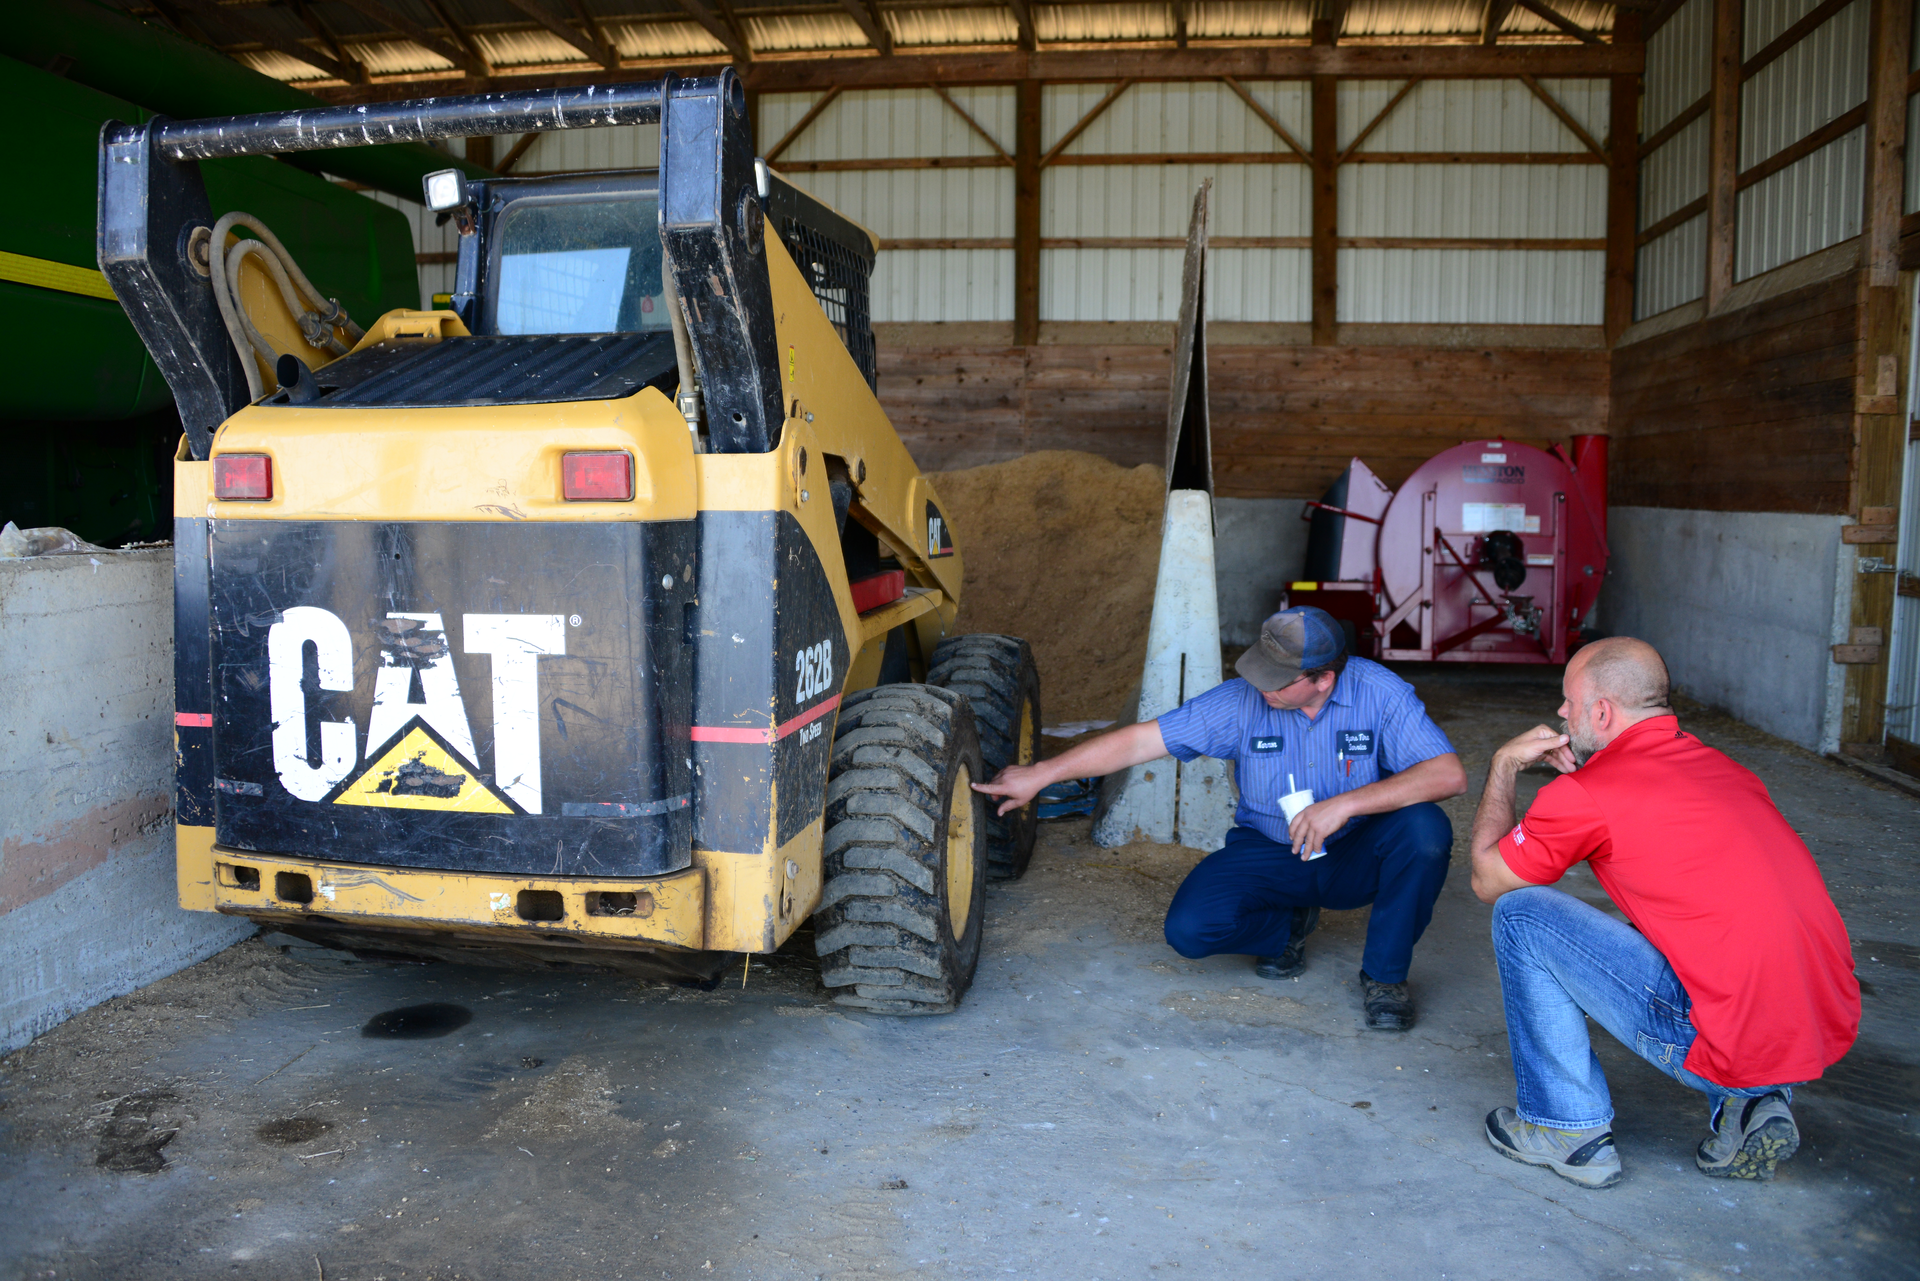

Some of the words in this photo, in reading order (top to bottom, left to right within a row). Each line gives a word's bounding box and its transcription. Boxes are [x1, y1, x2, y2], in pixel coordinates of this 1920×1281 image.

[928, 517, 942, 555] CAT
[795, 639, 833, 705] 262B
[268, 605, 567, 815] CAT
